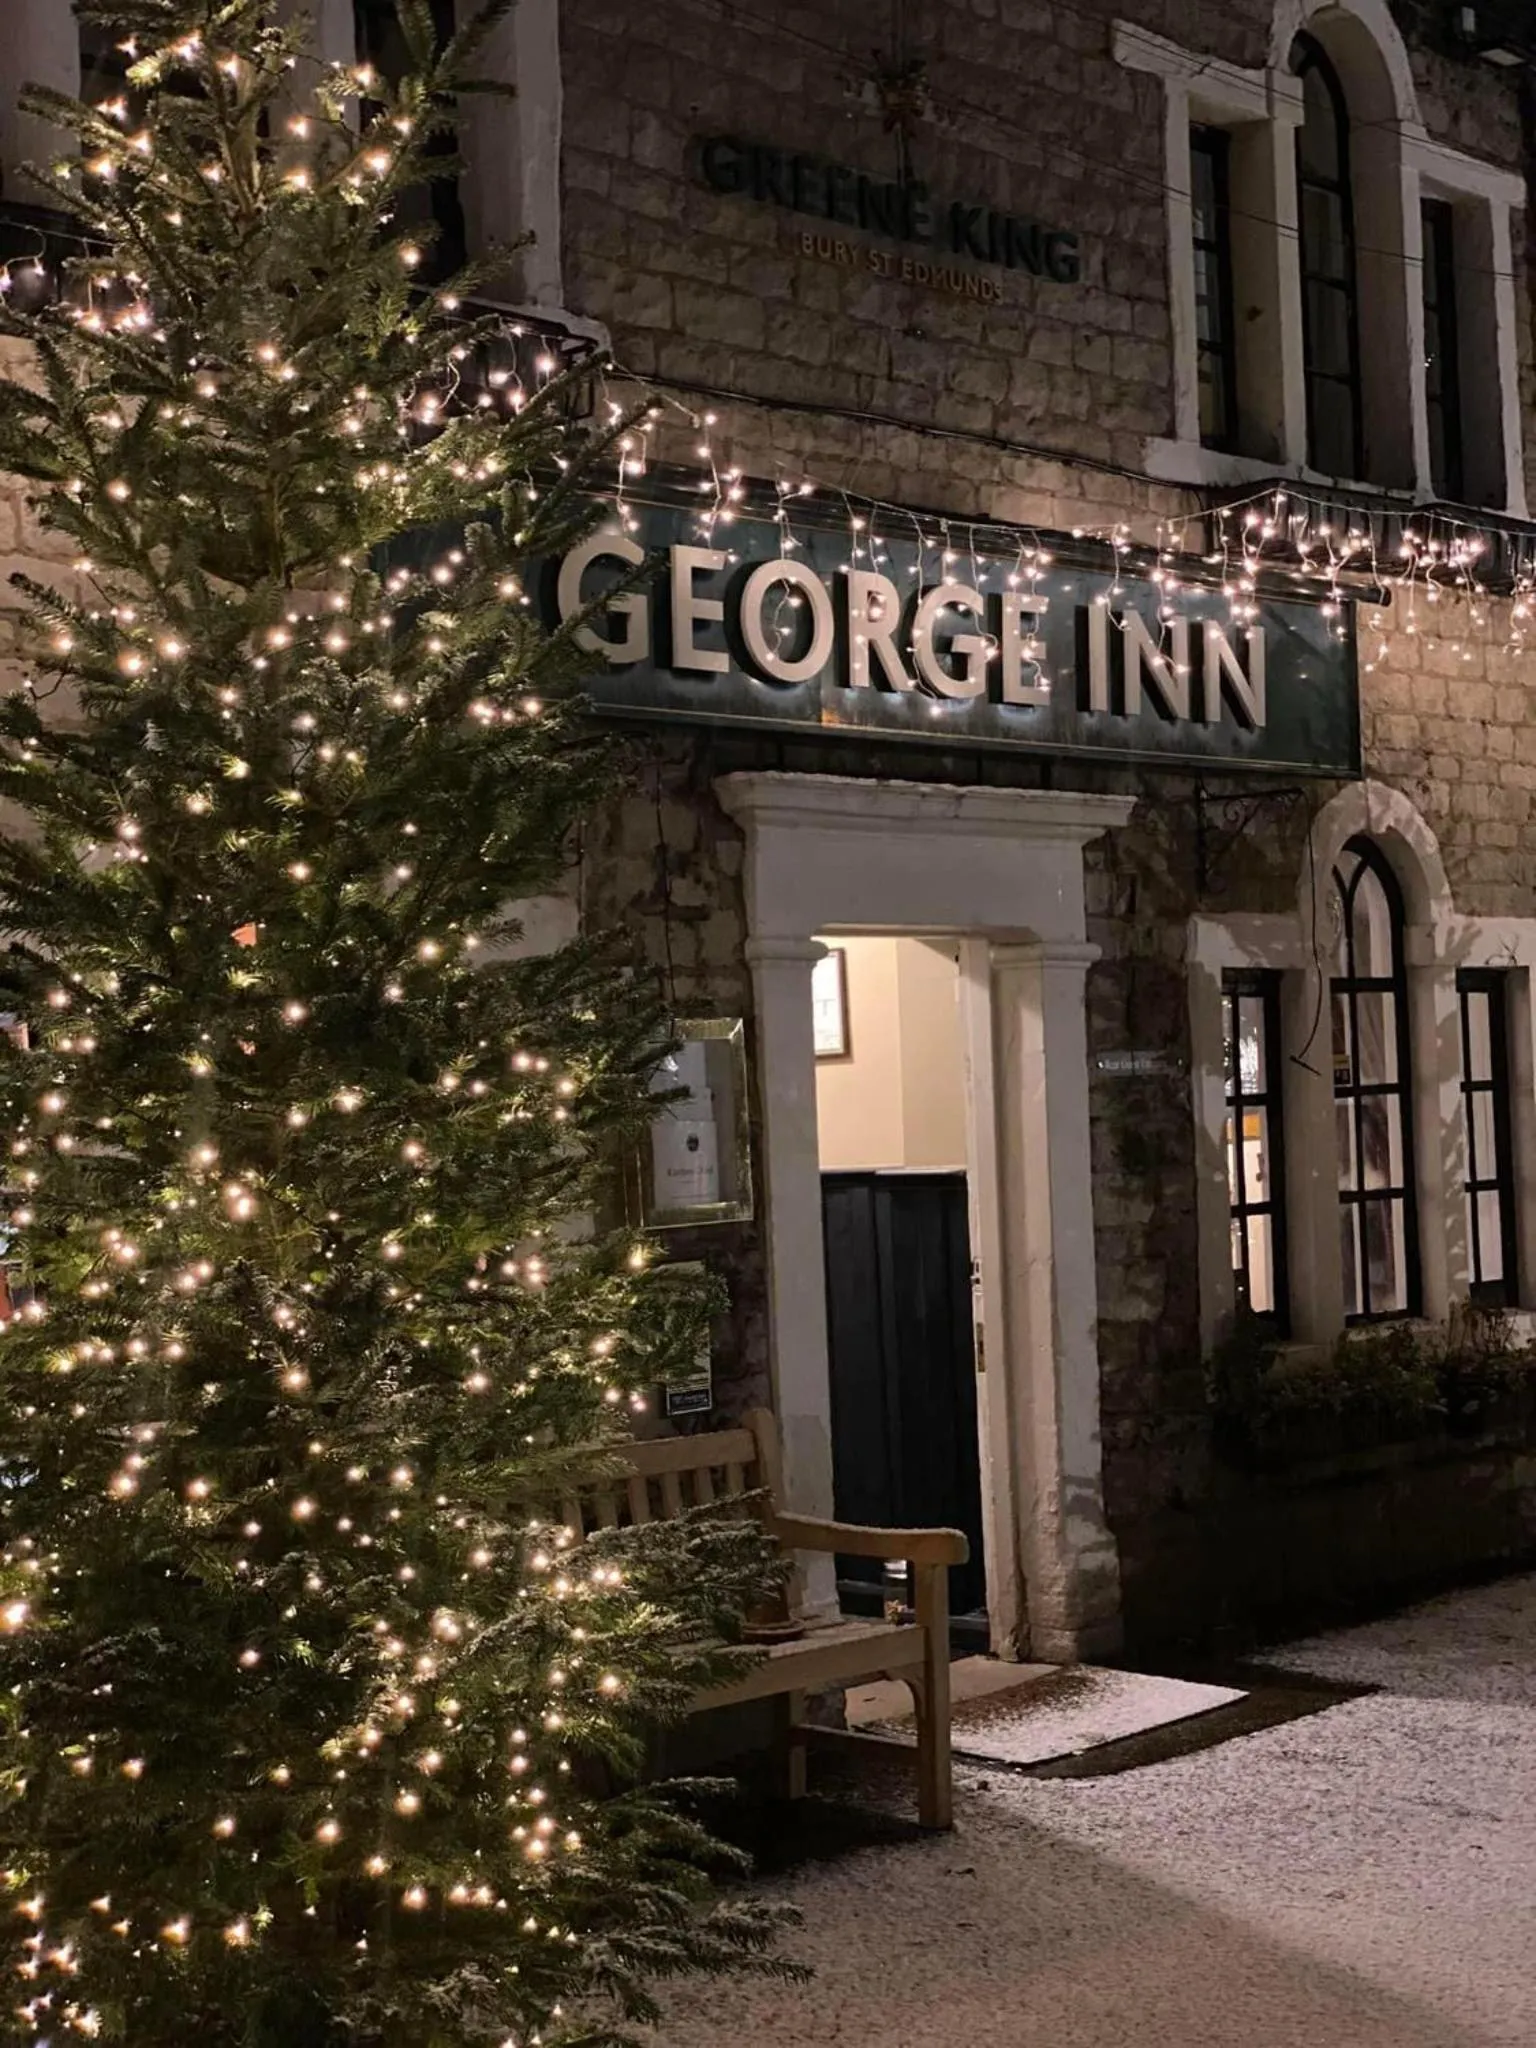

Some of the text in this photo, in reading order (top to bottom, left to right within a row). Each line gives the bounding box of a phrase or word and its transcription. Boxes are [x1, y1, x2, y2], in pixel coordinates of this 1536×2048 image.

[702, 135, 1081, 284] GREENE KING
[801, 231, 1005, 304] BURY ST EDMUNDS
[557, 533, 1267, 727] GEORGE INN
